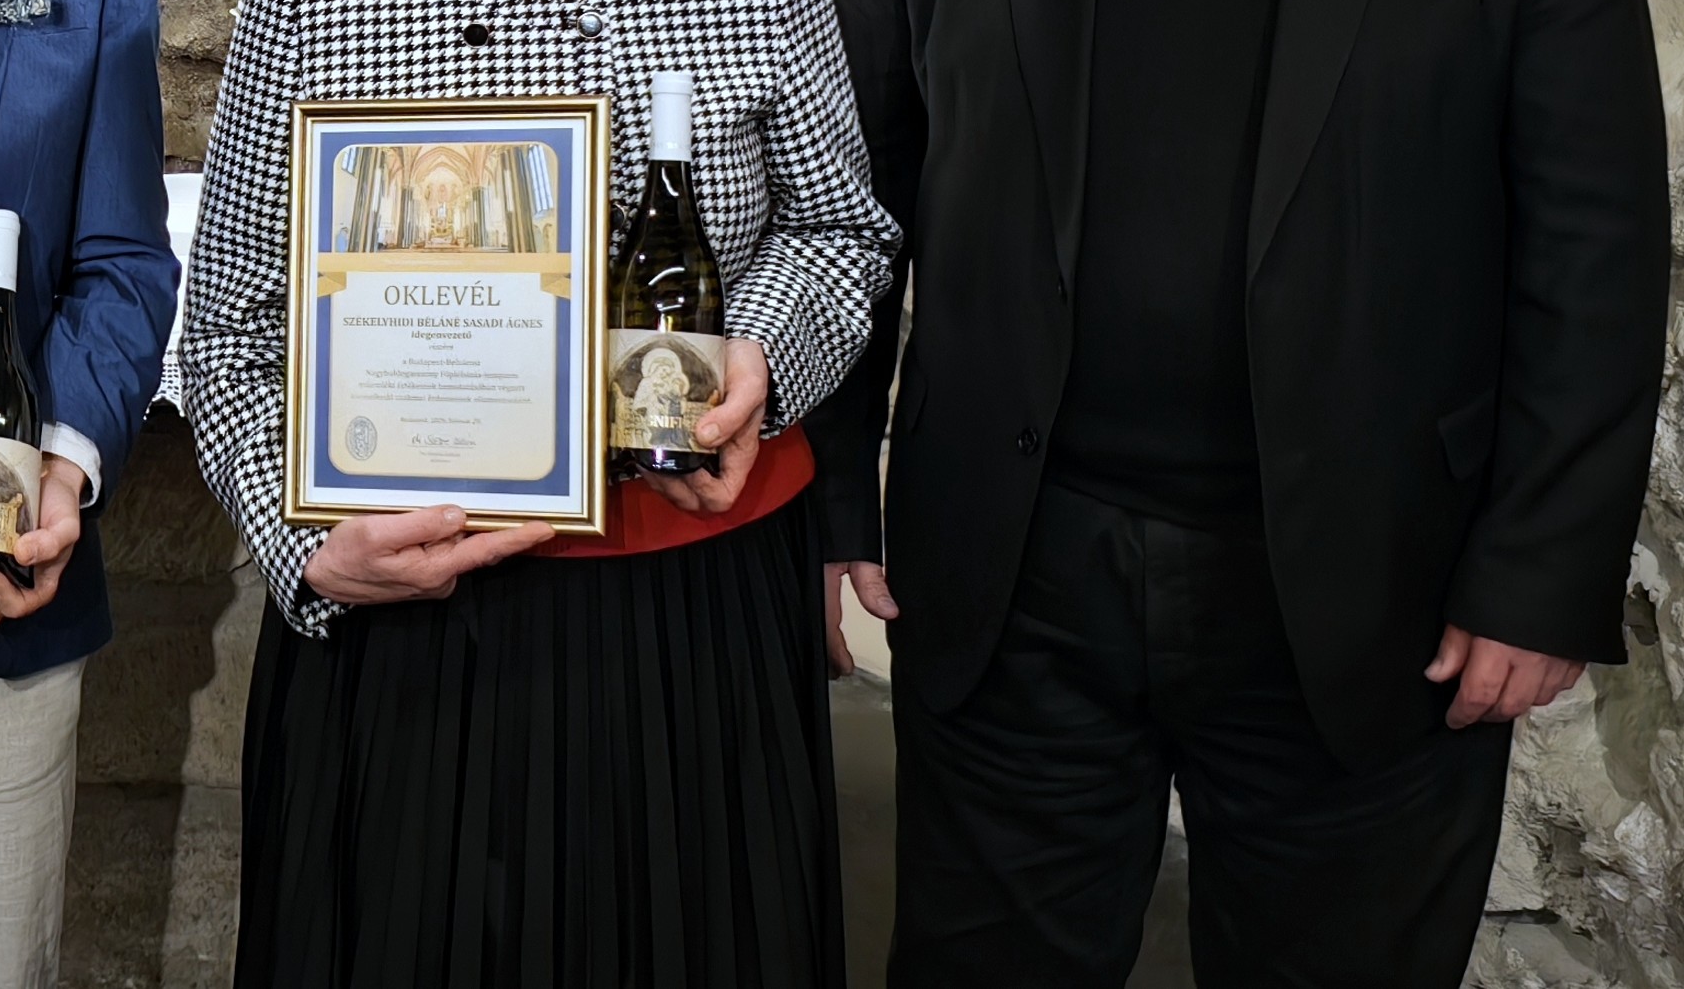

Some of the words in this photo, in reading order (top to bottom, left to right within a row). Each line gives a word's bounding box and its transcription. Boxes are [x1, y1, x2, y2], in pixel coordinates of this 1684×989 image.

[384, 281, 501, 306] OKLEVÉL
[463, 318, 503, 329] SASADI
[506, 317, 543, 329] ÁGNES
[411, 331, 472, 341] idegenvezető
